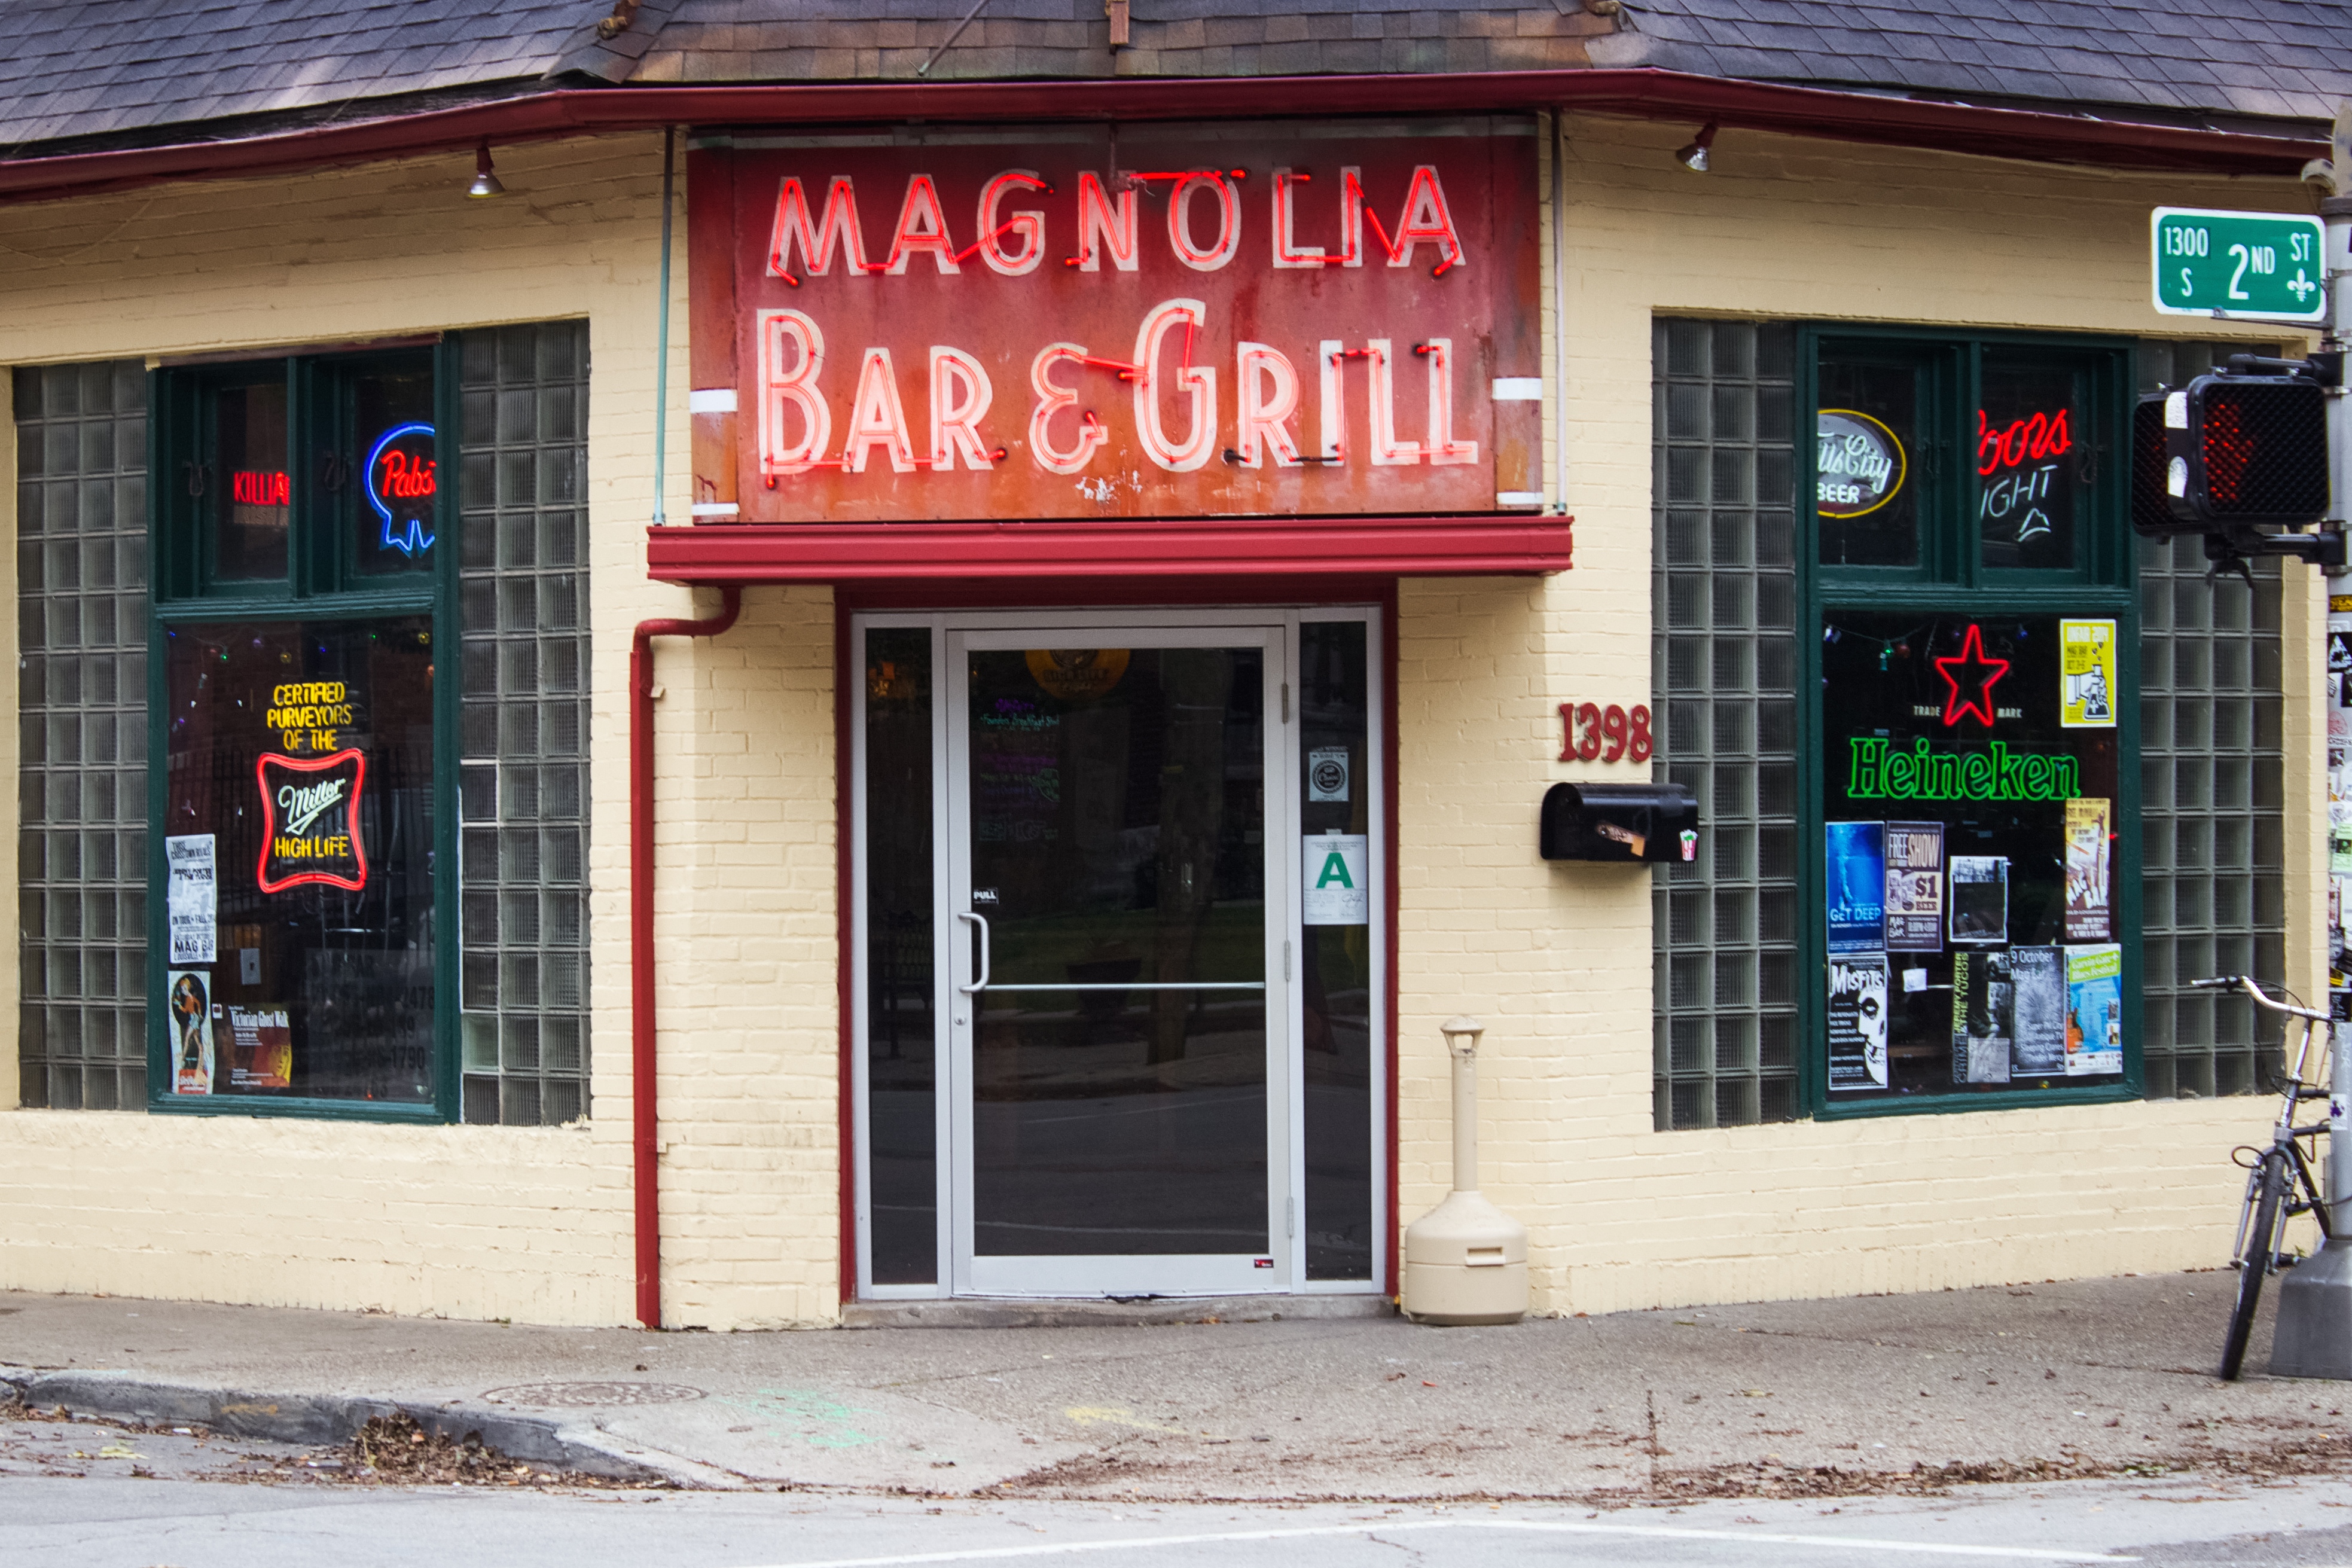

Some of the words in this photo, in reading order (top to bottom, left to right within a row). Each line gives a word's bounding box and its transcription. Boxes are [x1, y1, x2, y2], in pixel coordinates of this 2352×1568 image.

[765, 164, 1466, 280] MAGNOLIA
[2164, 227, 2209, 257] 1300
[2180, 268, 2193, 297] S
[2228, 243, 2275, 300] 2ND
[2290, 233, 2311, 262] ST
[756, 307, 994, 476] BAR
[1030, 341, 1109, 475] &
[1133, 298, 1479, 474] GRILL
[1978, 408, 2072, 476] oors
[1980, 464, 2058, 519] IGHT
[273, 682, 346, 706] CERTIFIED
[267, 704, 353, 728] PURVEYORS
[1914, 705, 1941, 717] TRADE
[1997, 707, 2022, 718] MARK
[283, 730, 304, 750] OF
[312, 728, 338, 751] THE
[1559, 702, 1653, 762] 1398
[1848, 737, 2081, 800] Heineken
[277, 778, 346, 825] Miller
[274, 837, 312, 858] HIGH
[315, 836, 349, 858] LIFE
[1888, 833, 1908, 859] FREE
[1908, 833, 1940, 867] SHOW
[1316, 852, 1354, 889] A
[973, 890, 997, 899] PULL
[1915, 875, 1938, 899] $1
[1854, 907, 1881, 921] DEEP
[175, 939, 199, 953] MAG
